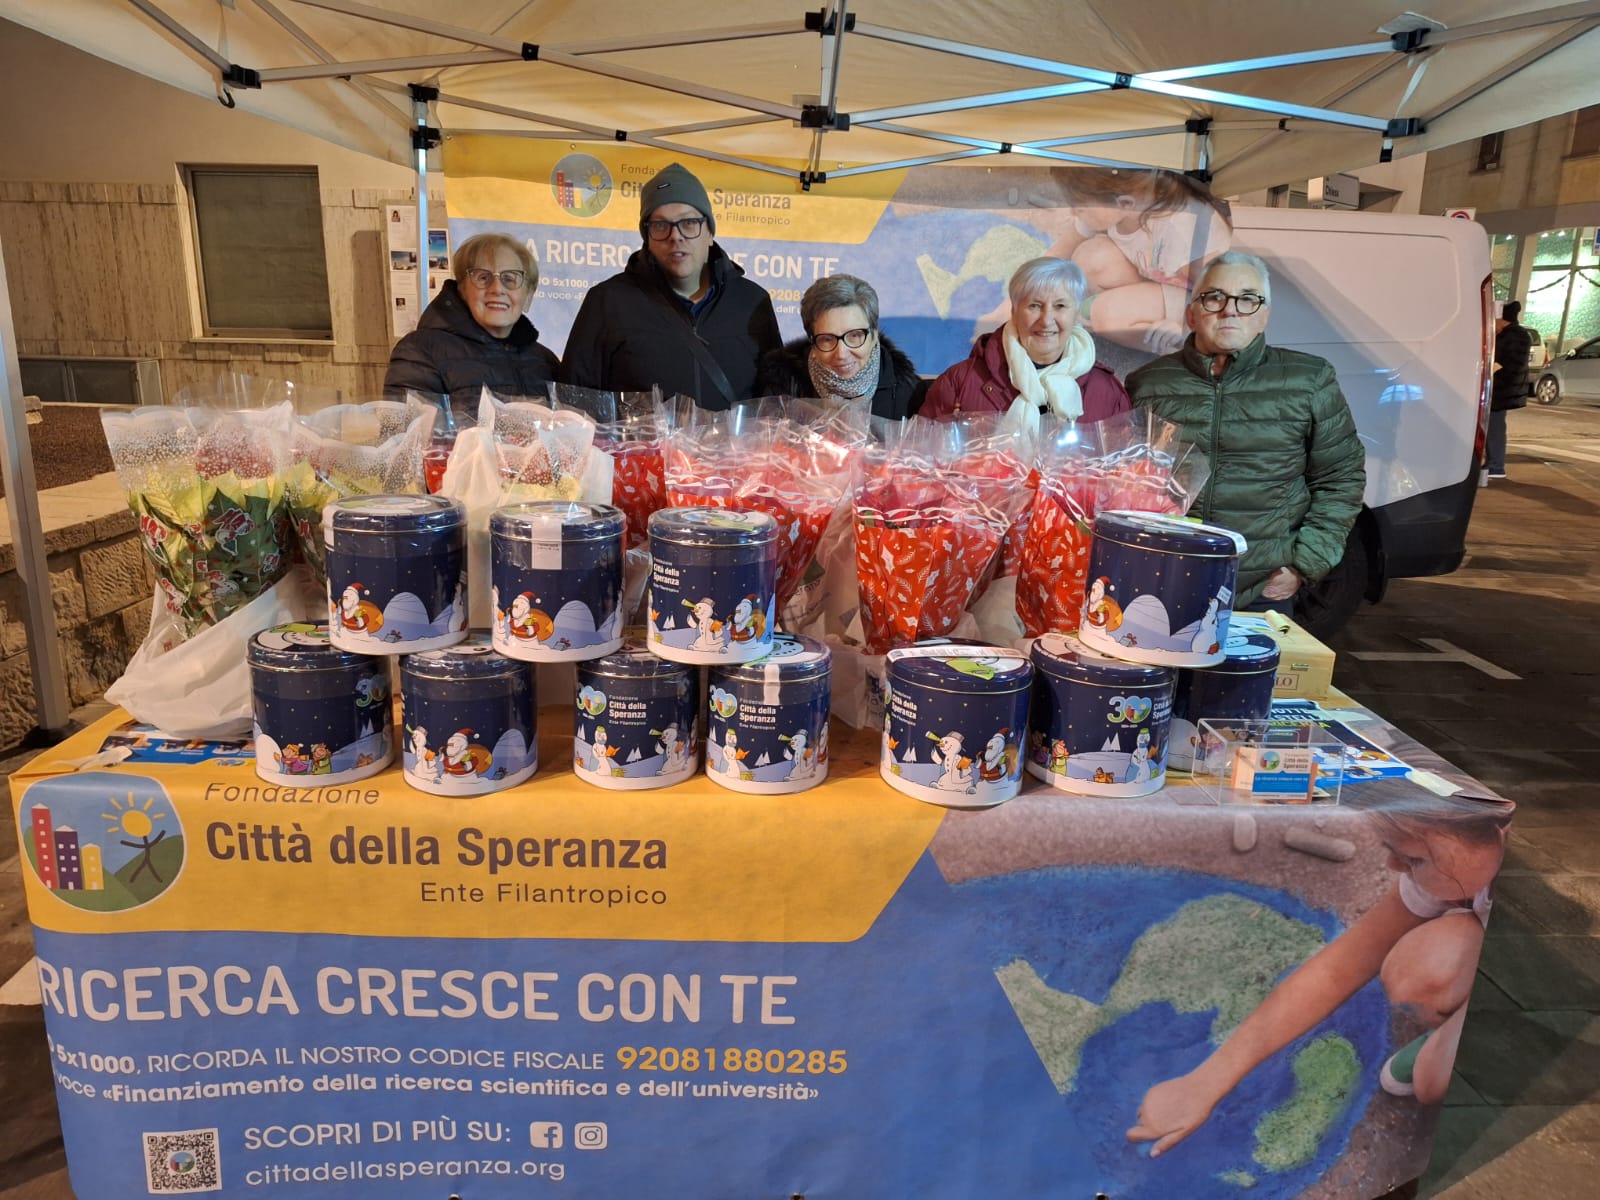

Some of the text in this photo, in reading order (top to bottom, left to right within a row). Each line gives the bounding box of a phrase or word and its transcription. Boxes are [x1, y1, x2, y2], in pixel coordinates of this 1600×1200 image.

[620, 163, 656, 176] Fonda
[621, 181, 641, 198] Cit
[712, 188, 791, 210] Speranza
[726, 212, 791, 226] Filantropico
[546, 239, 634, 268] RICERC
[754, 254, 803, 279] CON
[608, 700, 647, 710] Città della
[608, 709, 647, 719] Speranza
[757, 707, 777, 715] della
[739, 712, 776, 723] Speranza
[204, 782, 380, 805] Fondazione
[206, 821, 667, 875] Città della Speranza
[421, 882, 667, 908] Ente Filantropico
[37, 957, 798, 1025] RICERCA CRESCE CON TE
[56, 1044, 848, 1075] 5x1000, RICORDA IL NOSTRO CODICE FISCALE 92081880285
[102, 1074, 304, 1103] «Finanziamento
[312, 1074, 377, 1092] della
[385, 1074, 473, 1092] ricerca
[480, 1078, 608, 1096] scientifica
[615, 1082, 632, 1096] e
[243, 1115, 512, 1150] SCOPRI DI PIÙ SU:
[245, 1159, 566, 1187] cittadellasperanza.org
